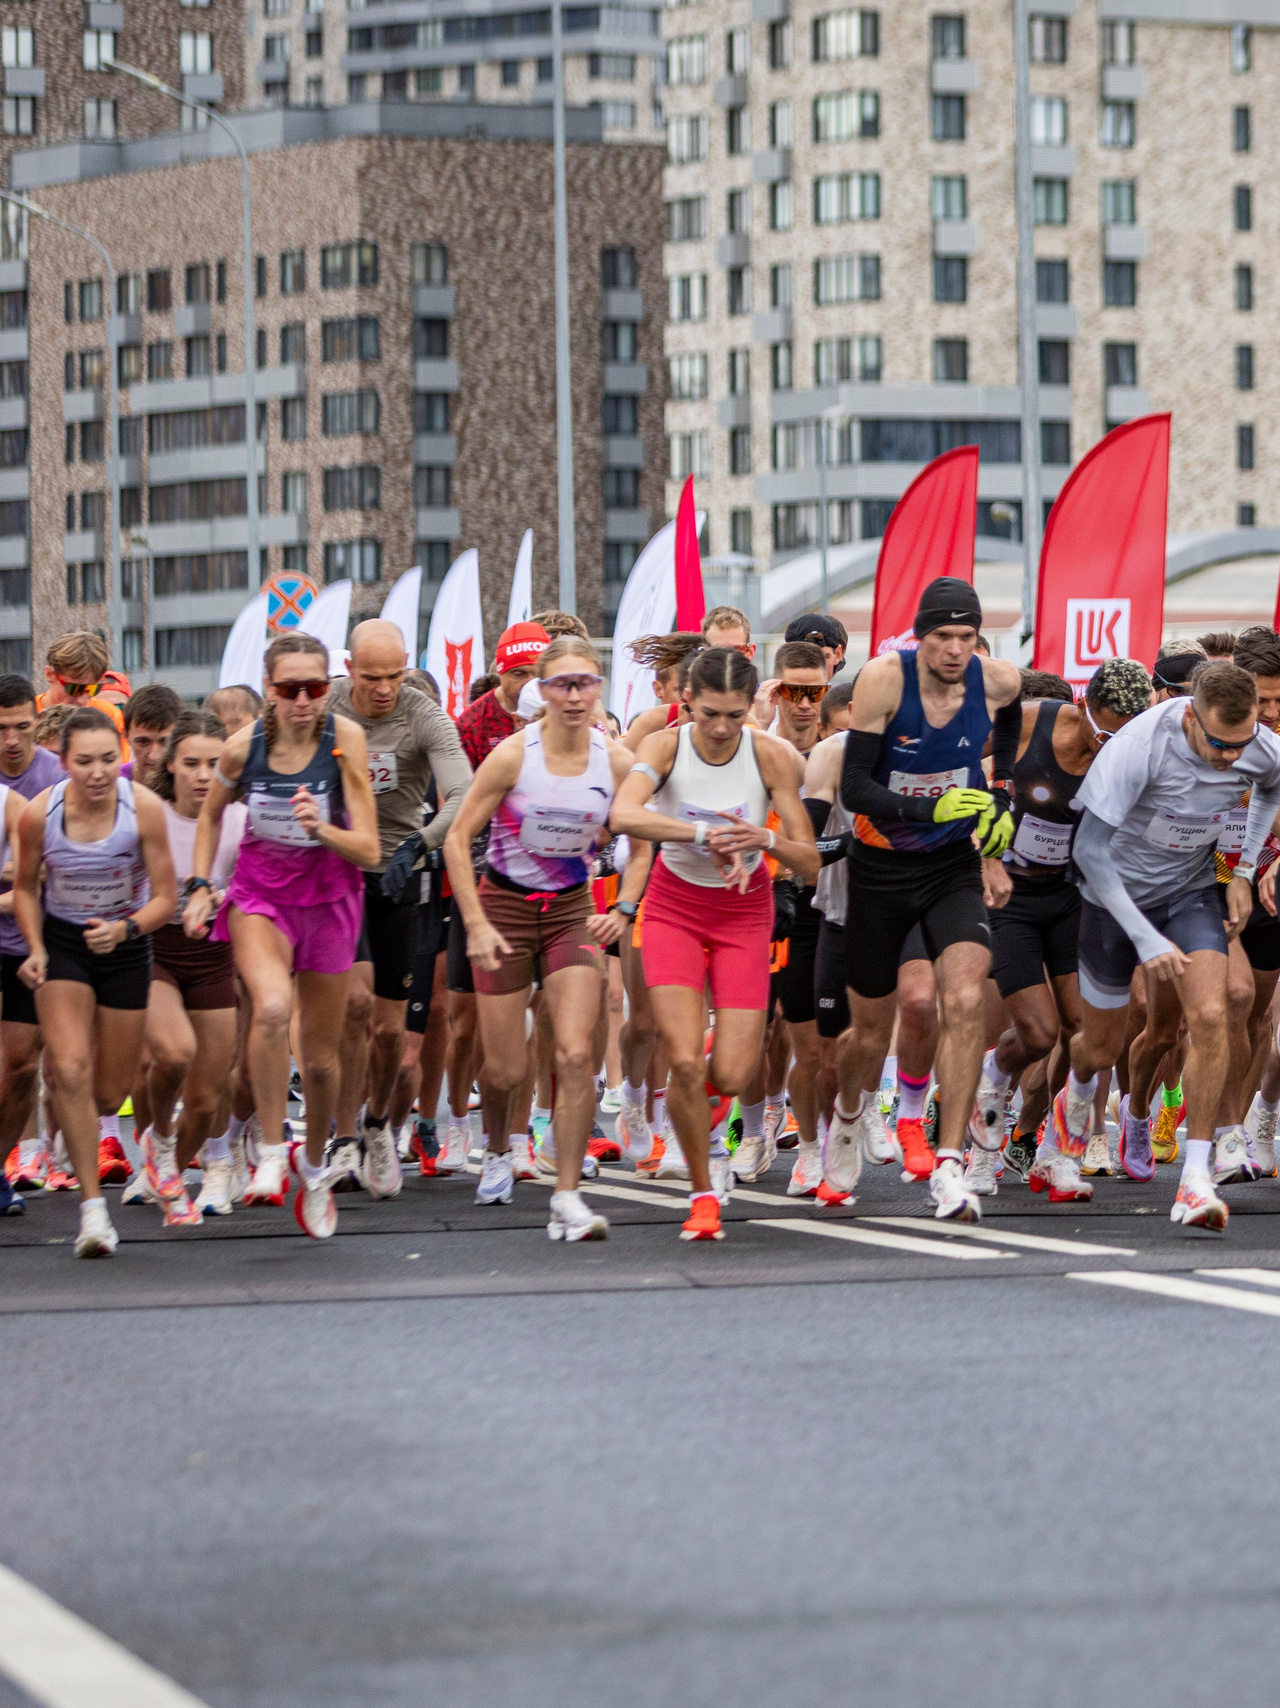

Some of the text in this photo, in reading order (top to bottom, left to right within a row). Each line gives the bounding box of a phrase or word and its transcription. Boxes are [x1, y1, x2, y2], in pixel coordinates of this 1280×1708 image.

[899, 783, 958, 798] 158
[537, 824, 582, 834] МОКИНА
[1169, 826, 1206, 834] ГУЩИН
